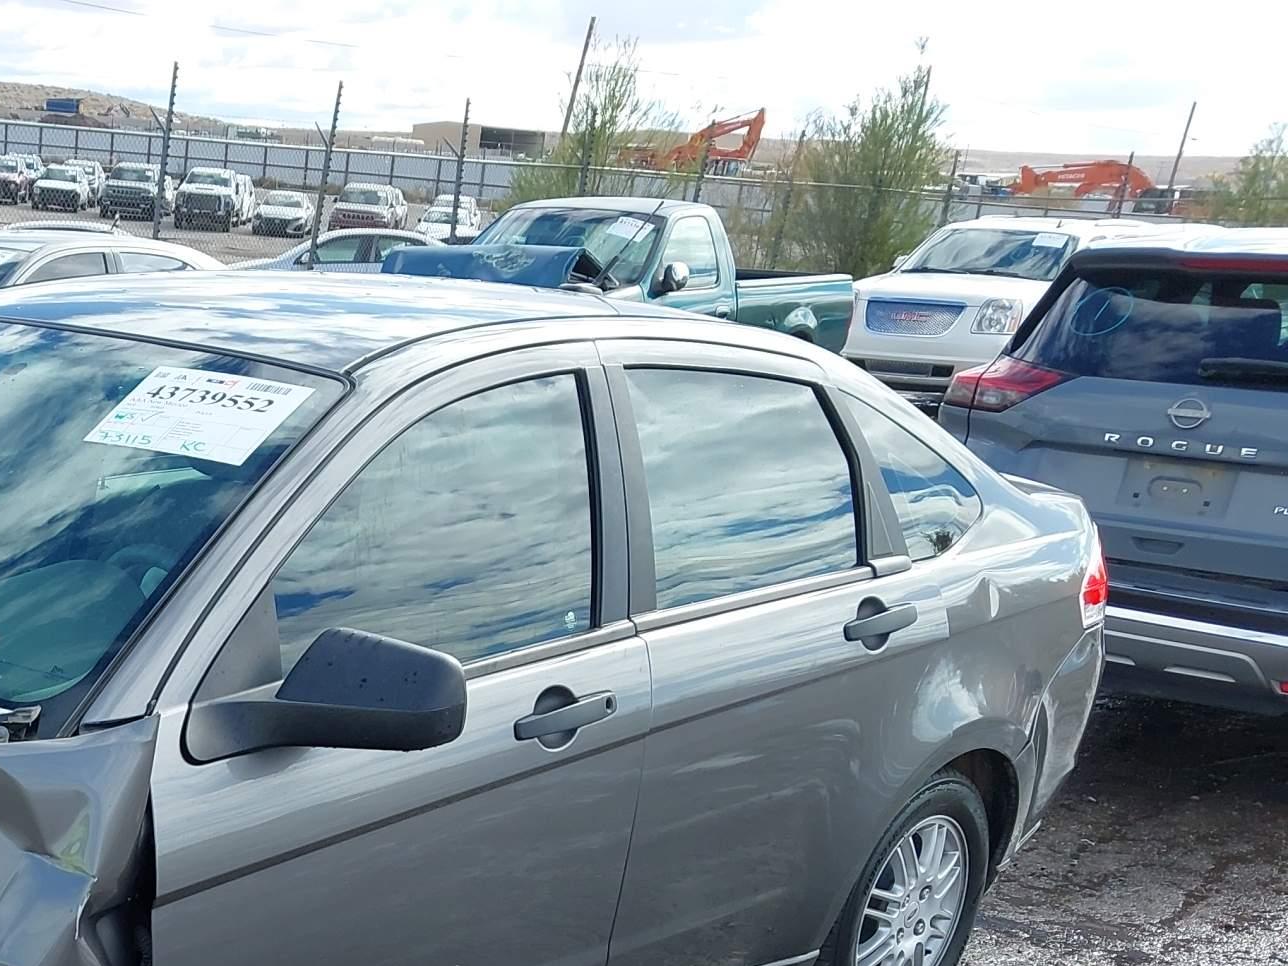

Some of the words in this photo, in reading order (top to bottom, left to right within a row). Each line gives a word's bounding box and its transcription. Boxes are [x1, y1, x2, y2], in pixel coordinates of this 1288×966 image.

[146, 384, 275, 413] 43739552
[179, 439, 207, 452] KC
[1103, 432, 1258, 458] ROGUE
